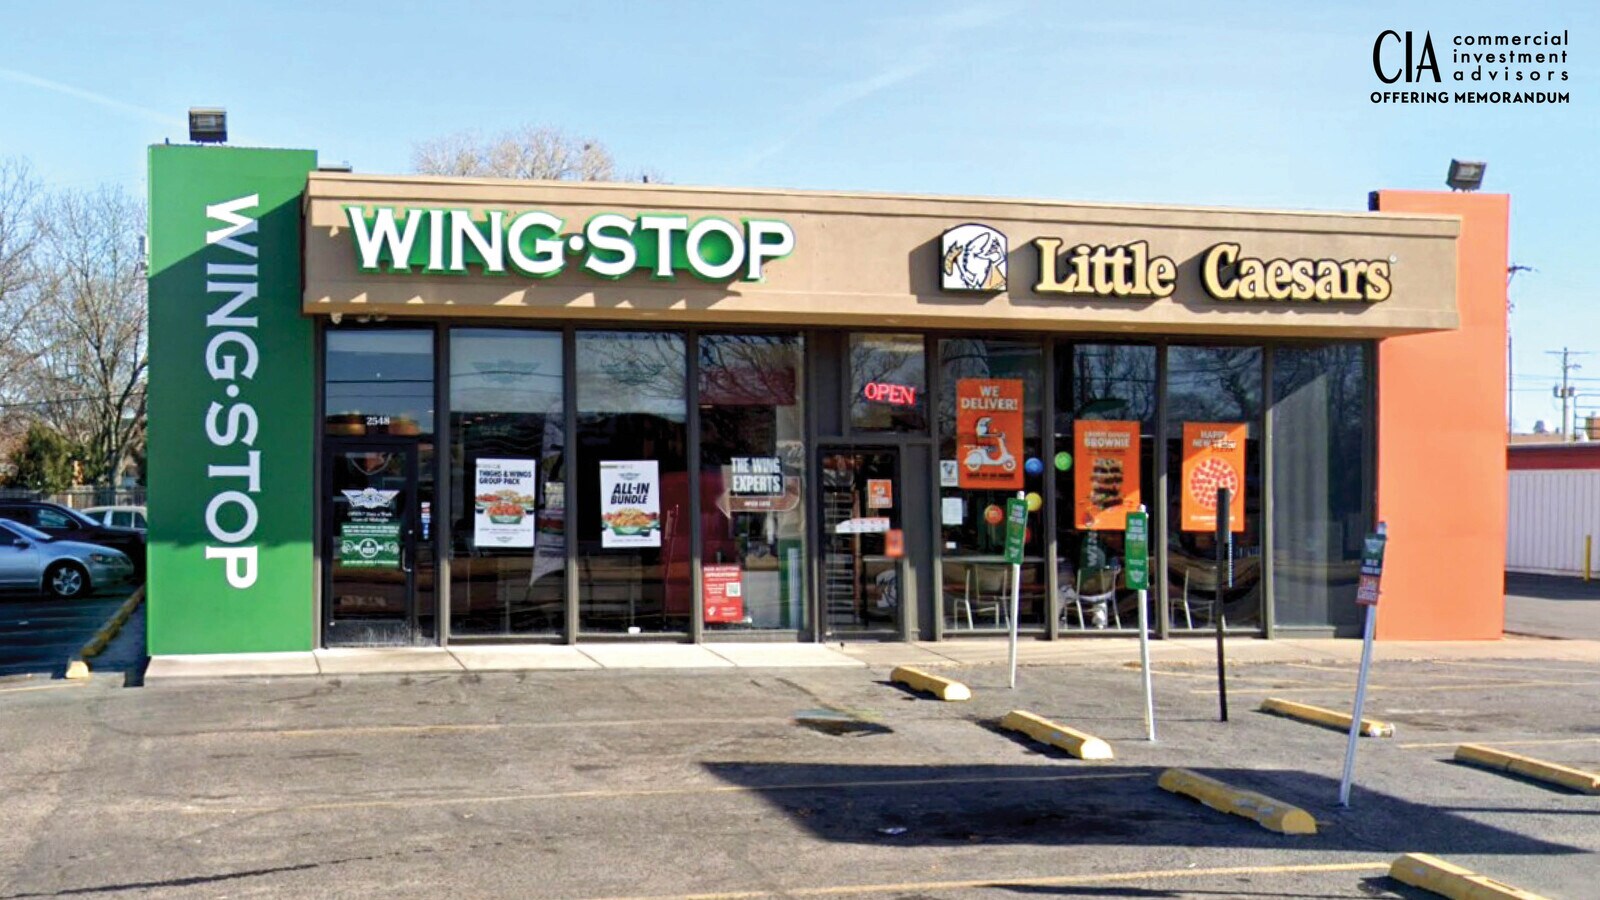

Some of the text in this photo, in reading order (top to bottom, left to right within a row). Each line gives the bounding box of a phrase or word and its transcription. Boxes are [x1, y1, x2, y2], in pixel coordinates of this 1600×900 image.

[1034, 237, 1392, 302] Little Caesars
[864, 382, 916, 405] OPEN
[980, 385, 1000, 397] WE
[961, 397, 1018, 411] DELIVER!
[366, 416, 390, 426] 2548
[731, 457, 780, 473] THE WING
[613, 482, 650, 495] ALL-IN
[733, 475, 781, 493] EXPERTS
[610, 494, 648, 505] BUNDLE
